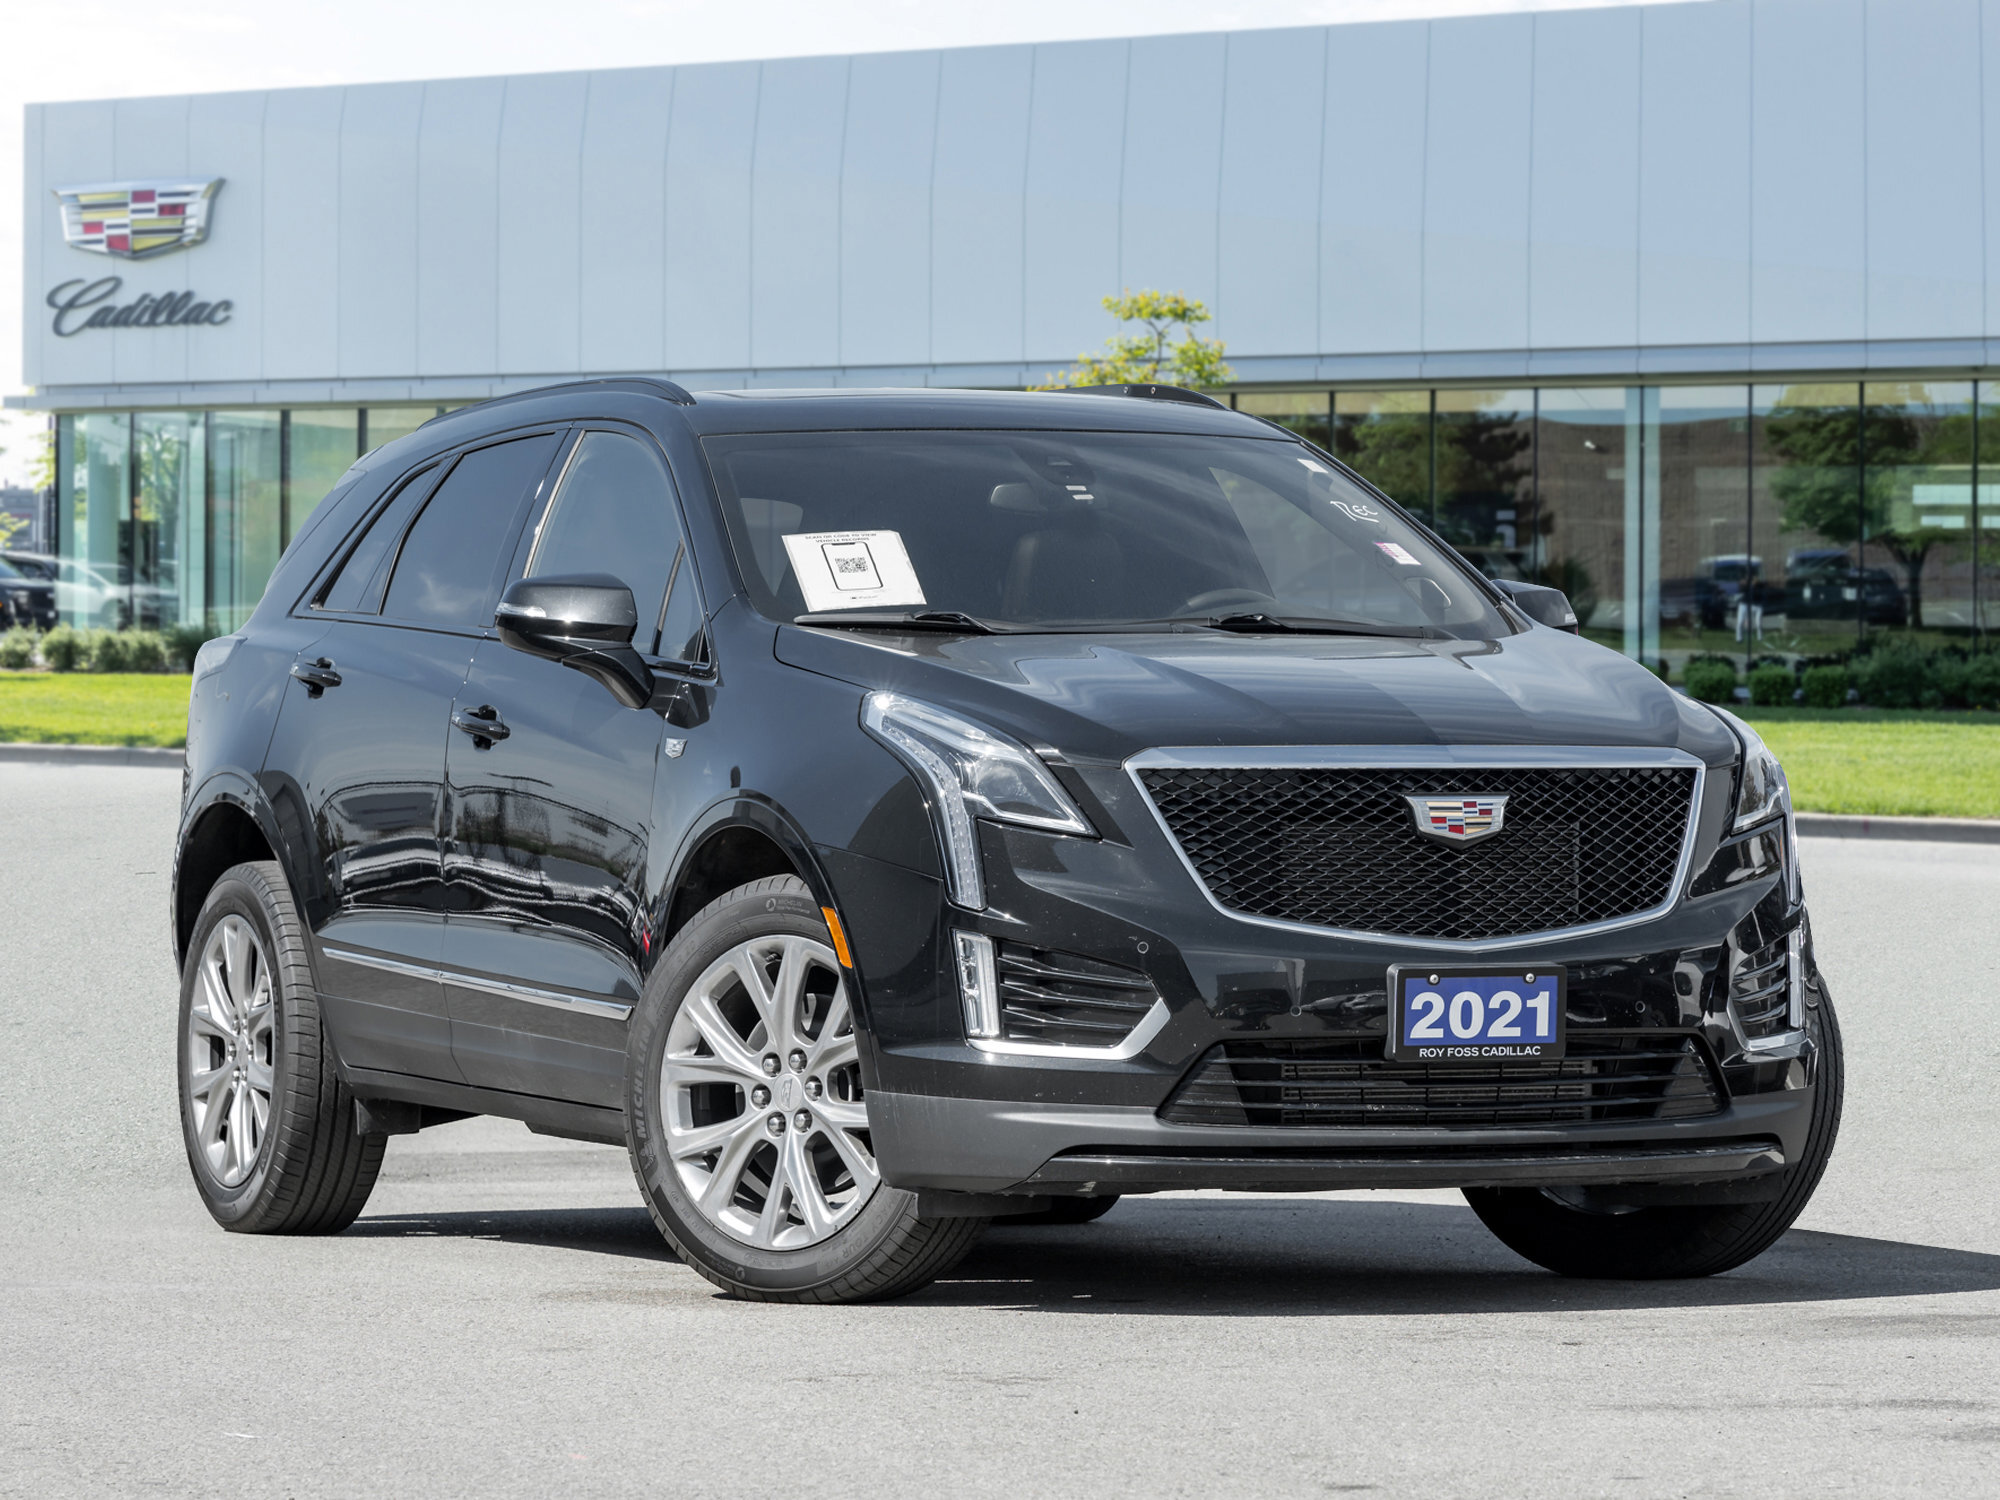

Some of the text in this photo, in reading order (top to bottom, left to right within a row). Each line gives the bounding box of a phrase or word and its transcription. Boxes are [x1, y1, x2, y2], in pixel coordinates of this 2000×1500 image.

[46, 276, 234, 338] Cadillac
[1409, 990, 1550, 1039] 2021
[1419, 1046, 1541, 1058] ROY FOSS CADILLAC
[634, 1026, 652, 1139] MICHELIN
